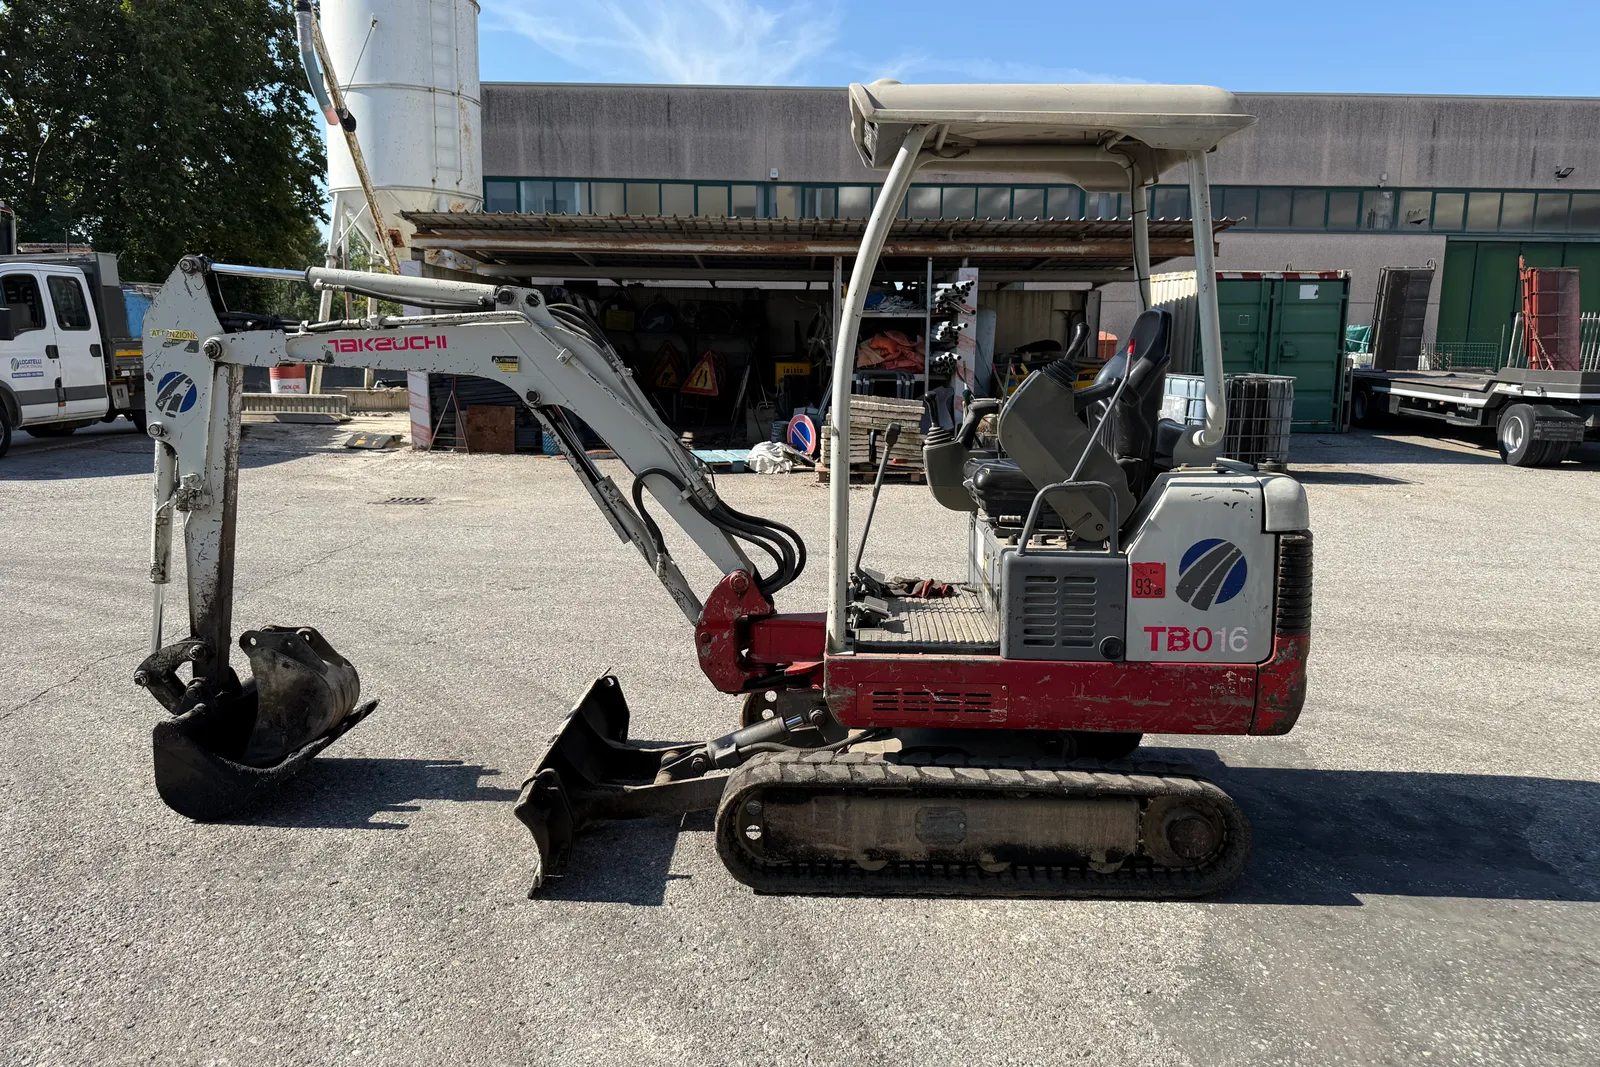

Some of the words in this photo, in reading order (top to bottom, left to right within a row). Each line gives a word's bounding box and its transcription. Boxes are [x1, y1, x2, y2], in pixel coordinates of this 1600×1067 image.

[327, 335, 447, 353] TAKEUCHI
[783, 366, 803, 374] inizio
[1136, 578, 1151, 595] 93
[1143, 626, 1249, 652] TB016
